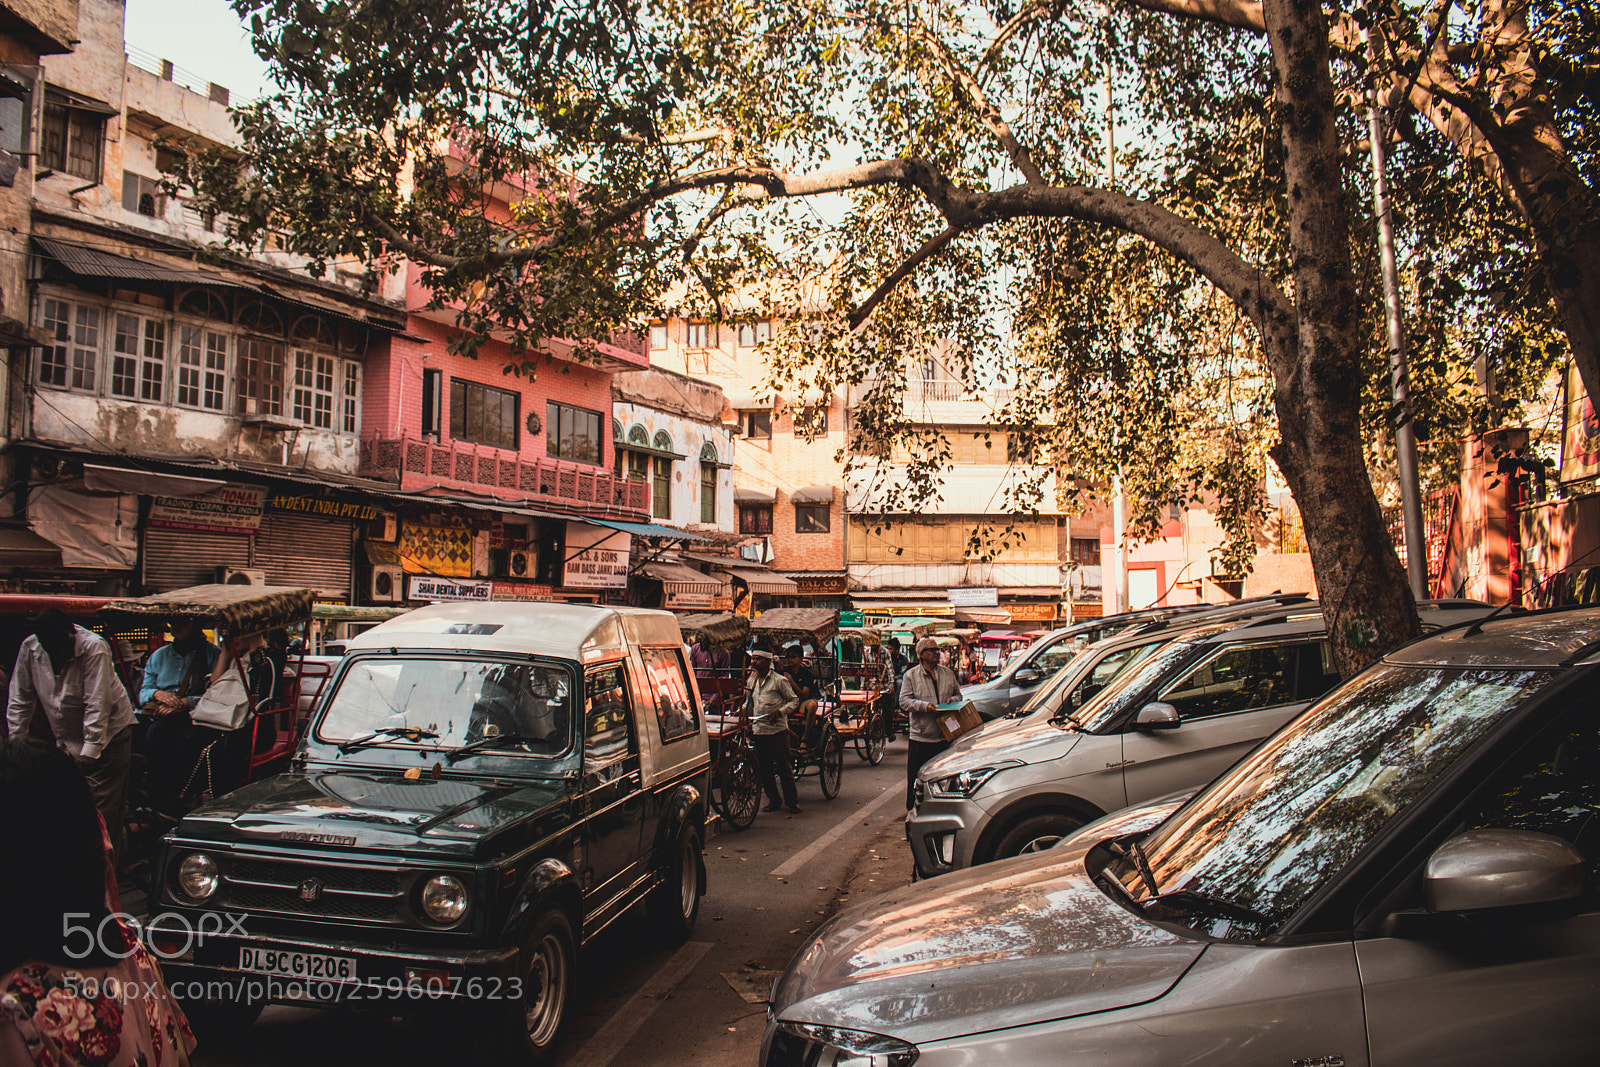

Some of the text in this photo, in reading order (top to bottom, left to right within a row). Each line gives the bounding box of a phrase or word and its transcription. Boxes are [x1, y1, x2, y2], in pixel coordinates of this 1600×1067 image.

[157, 497, 260, 516] TRADING CORPN. OF INDIA
[313, 500, 339, 516] INDIA
[340, 503, 359, 518] PVT.
[360, 506, 378, 520] LTD.
[593, 551, 599, 561] &
[600, 552, 618, 563] SONS
[566, 562, 580, 573] RAM
[581, 563, 596, 575] DASS
[613, 566, 627, 576] DASS
[418, 582, 435, 594] SHAH
[436, 583, 457, 596] DENTAL
[458, 585, 489, 598] SUPPLIERS
[280, 830, 357, 847] MARUTI
